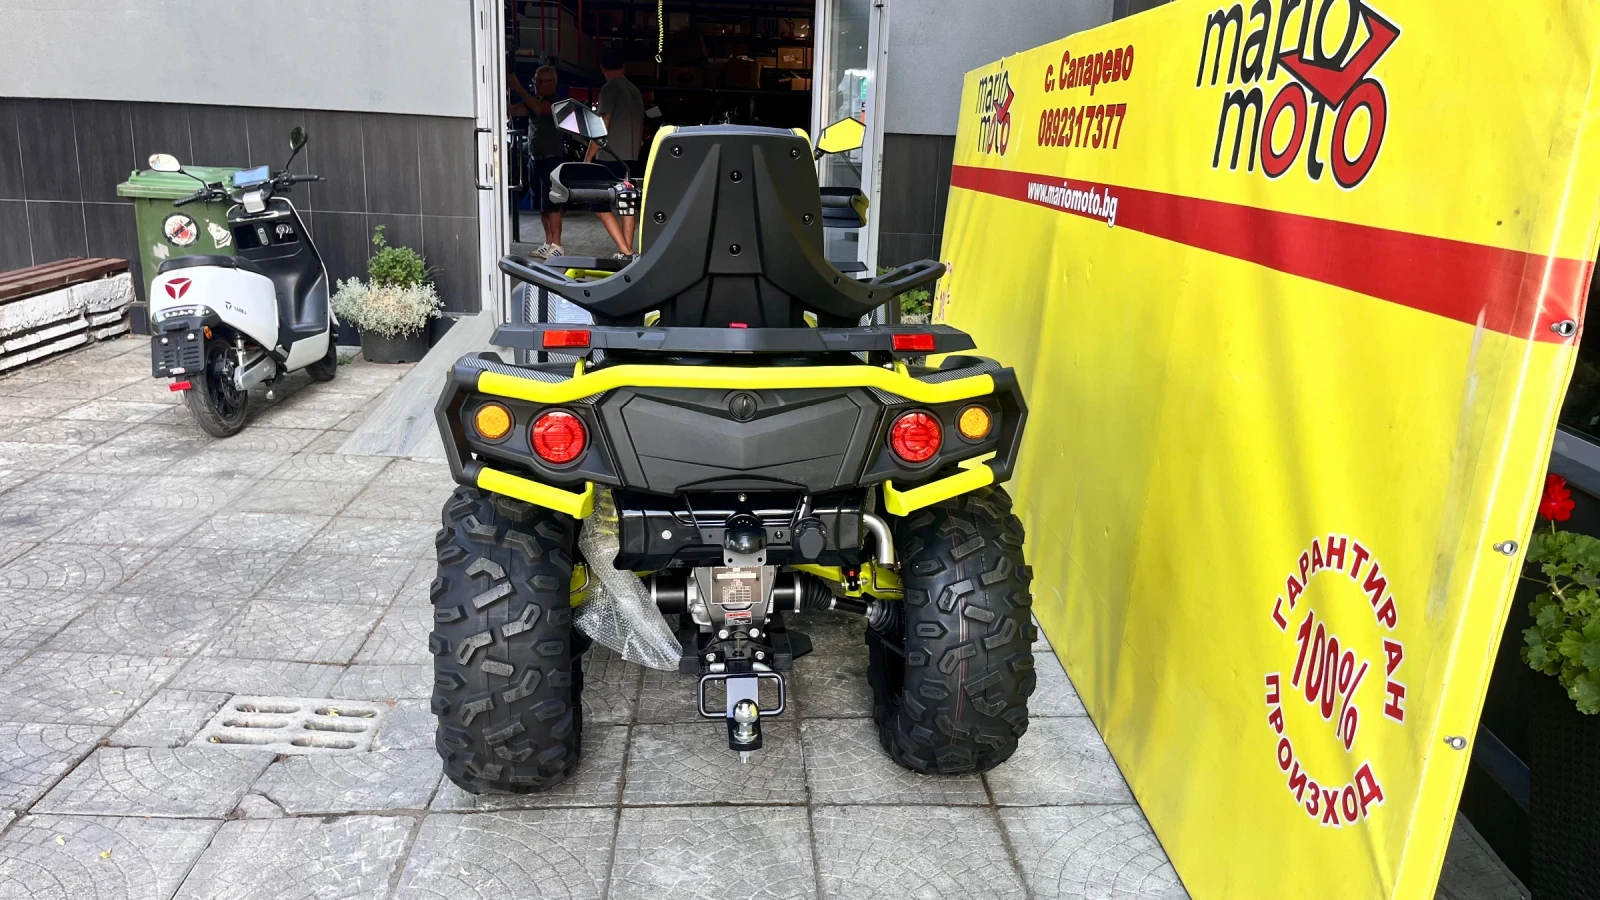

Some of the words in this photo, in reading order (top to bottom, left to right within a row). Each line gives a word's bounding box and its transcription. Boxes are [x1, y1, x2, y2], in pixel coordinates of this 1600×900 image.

[1059, 50, 1135, 97] Сапарево
[1196, 0, 1361, 85] mario
[975, 61, 1009, 114] mario
[977, 111, 1011, 157] moto
[1037, 102, 1128, 150] 0892317377
[1212, 77, 1388, 189] moto
[1027, 181, 1118, 227] www.mariomoto.bg
[1271, 535, 1406, 723] ГАРАНТИРАН
[1291, 610, 1370, 751] 100%
[1265, 673, 1385, 826] ПРОИЗХОД
